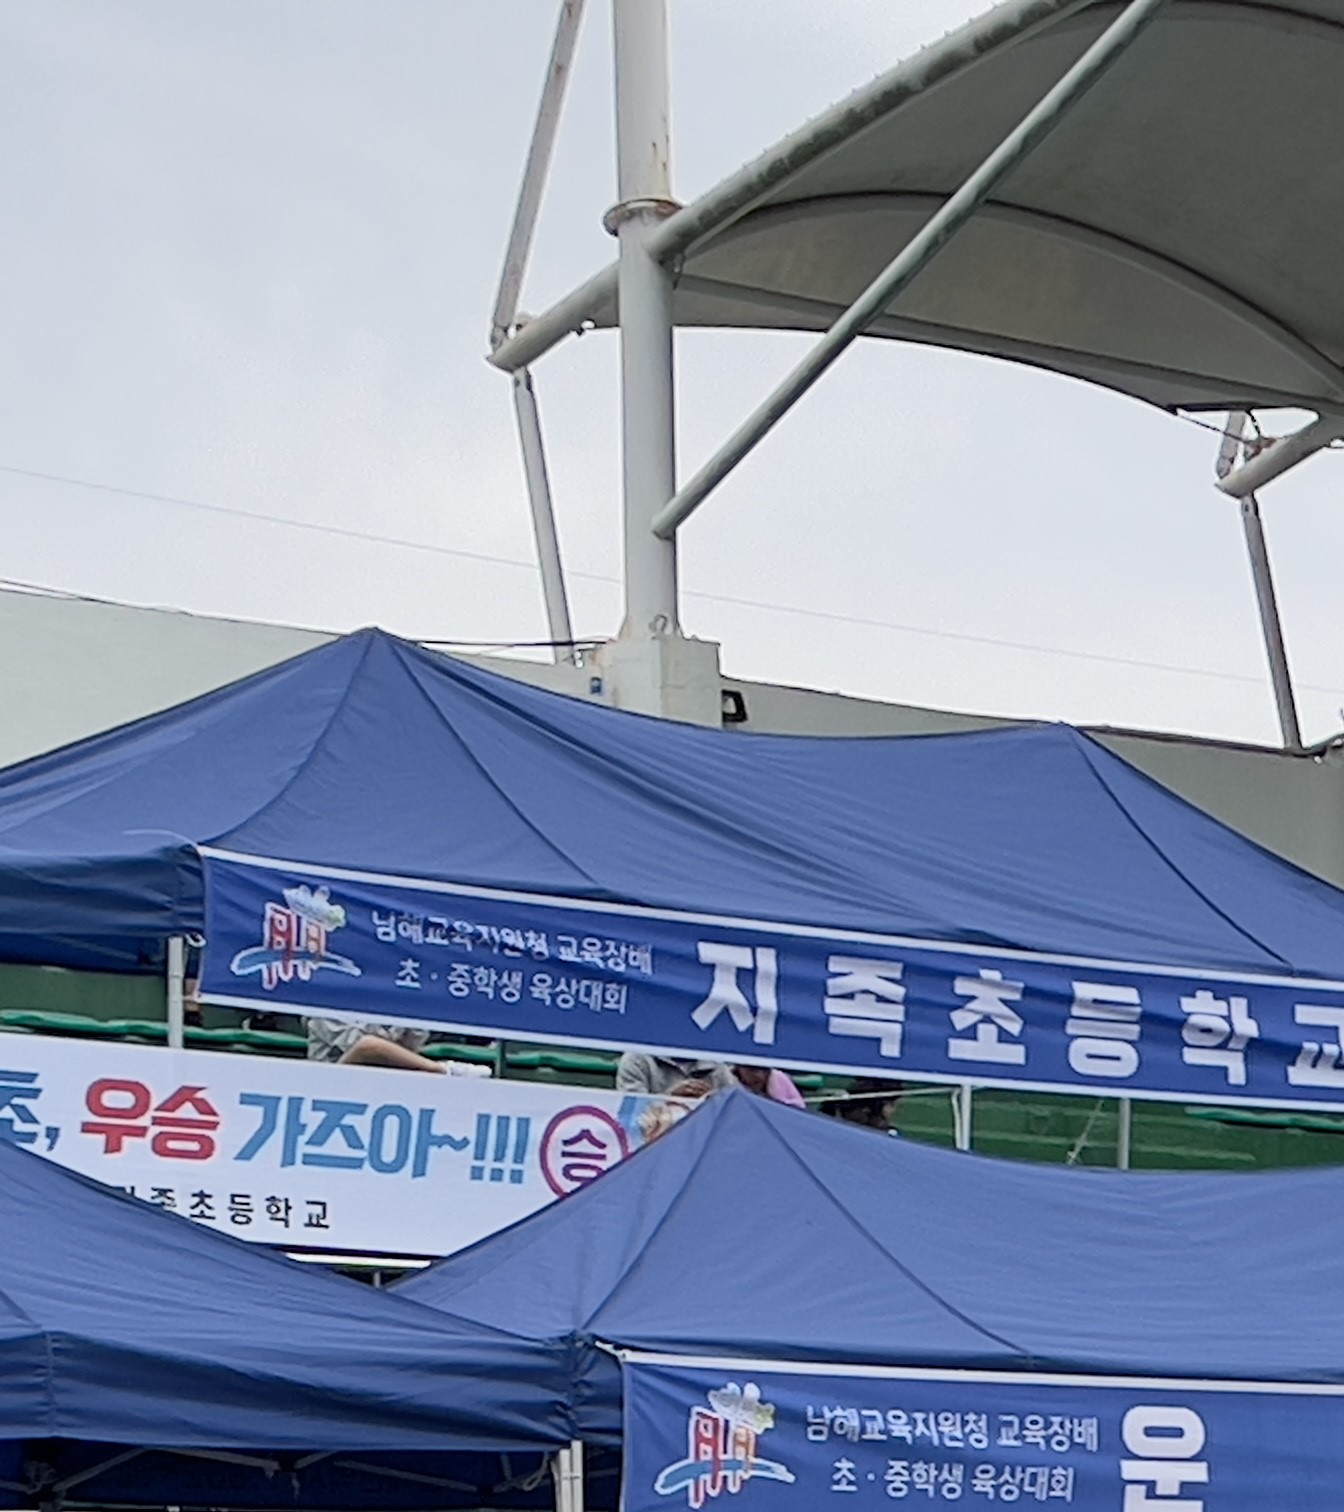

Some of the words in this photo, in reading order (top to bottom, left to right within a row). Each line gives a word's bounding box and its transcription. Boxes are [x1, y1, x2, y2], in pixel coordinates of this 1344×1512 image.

[371, 908, 549, 959] 남해교육지원청
[557, 931, 653, 976] 교육장배
[529, 976, 628, 1015] 육상대회
[81, 1078, 219, 1160] 우승
[805, 1403, 989, 1449] 남해교육지원청
[996, 1413, 1099, 1452] 교육장배
[970, 1462, 1074, 1502] 육상대회
